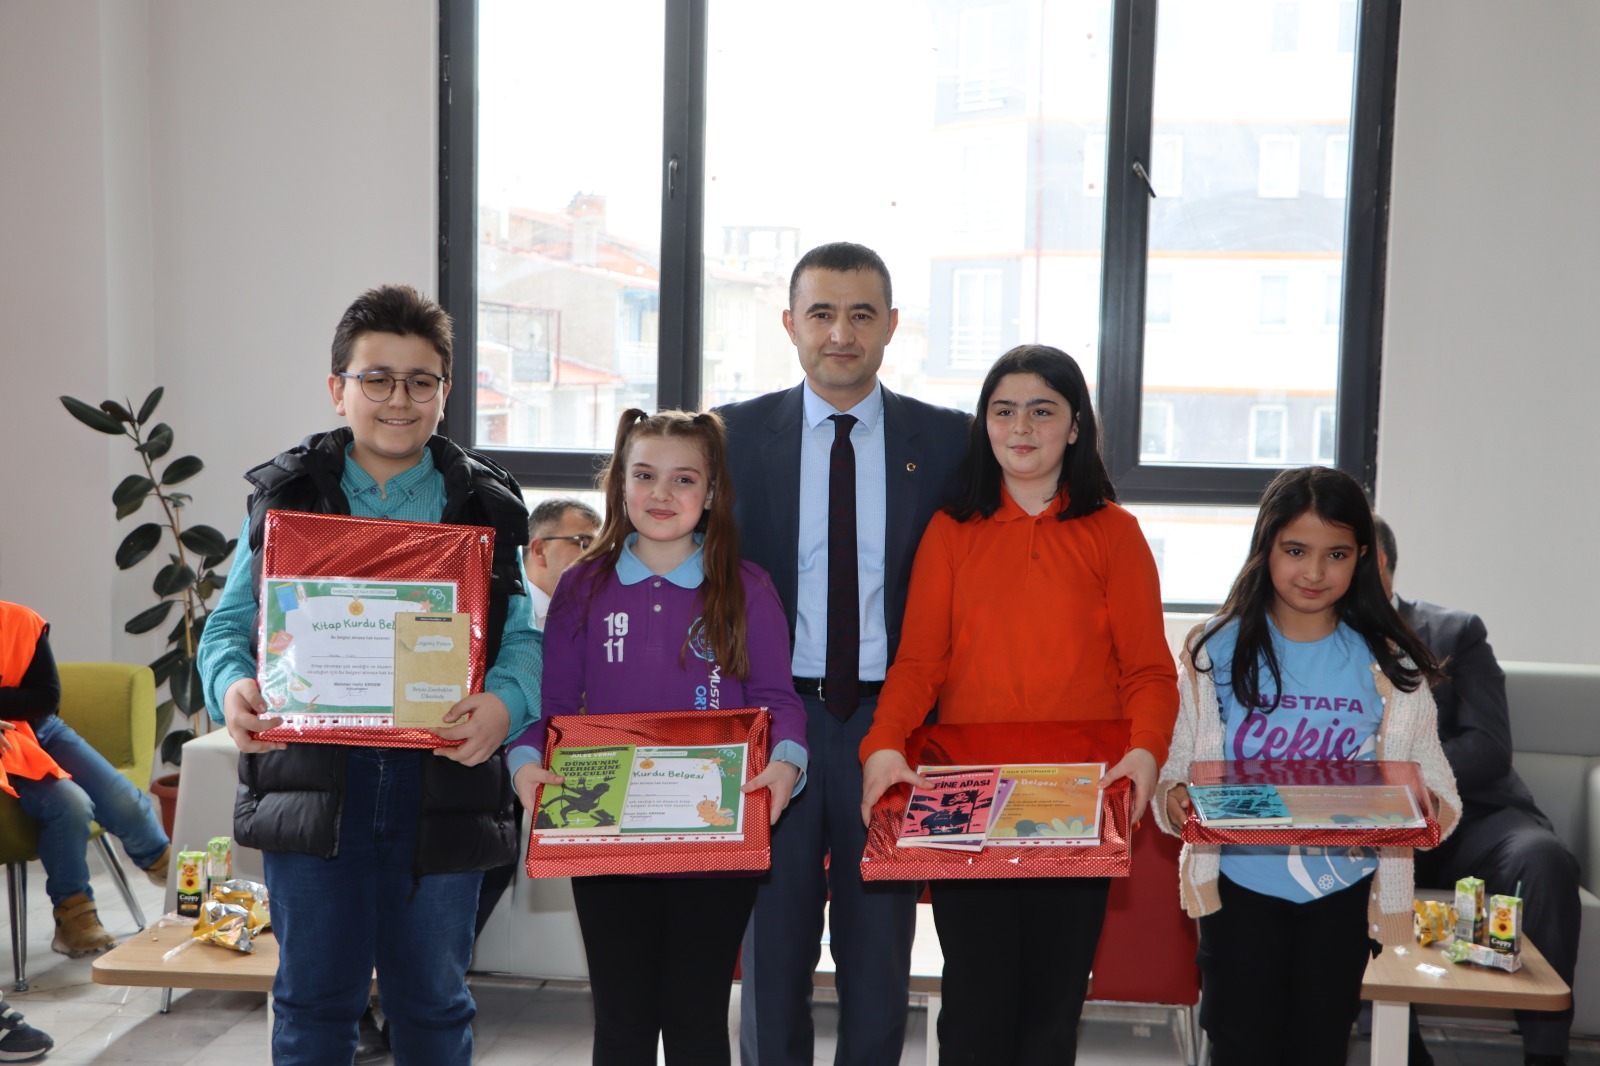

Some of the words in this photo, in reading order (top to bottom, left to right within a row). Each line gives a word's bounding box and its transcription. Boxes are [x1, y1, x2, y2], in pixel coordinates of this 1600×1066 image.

[312, 621, 342, 632] Kitap
[343, 618, 376, 628] Kurdu
[604, 612, 629, 637] 19
[604, 637, 625, 663] 11
[633, 769, 665, 777] Kurdu
[668, 770, 704, 780] Belgesi
[959, 779, 991, 789] ADASI
[1021, 778, 1058, 787] Belgesi
[179, 894, 200, 903] Cappy
